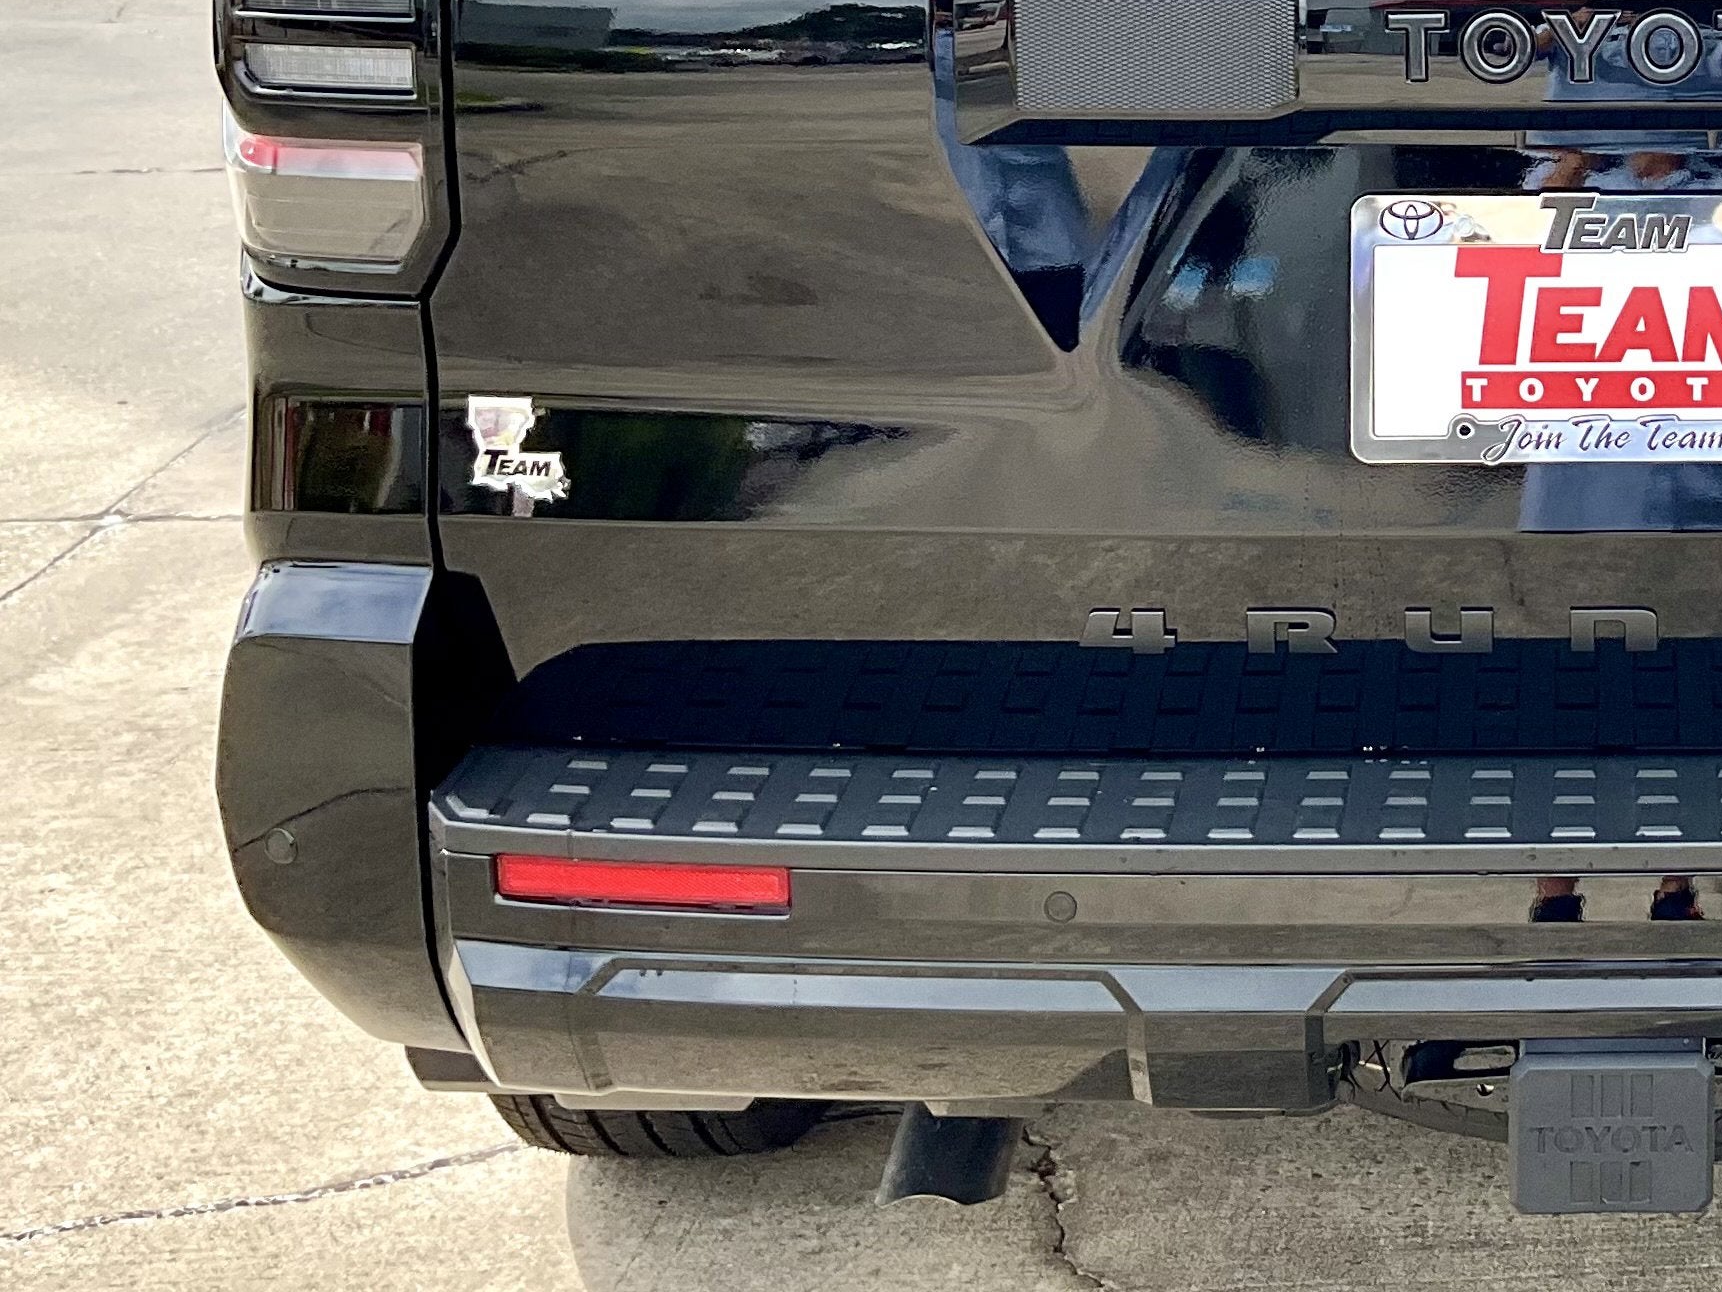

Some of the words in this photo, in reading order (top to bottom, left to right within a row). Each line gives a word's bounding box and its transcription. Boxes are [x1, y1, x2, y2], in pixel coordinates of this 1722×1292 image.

[1540, 195, 1691, 252] TEAM
[1482, 415, 1567, 461] Join
[1572, 417, 1632, 451] The
[484, 449, 552, 477] TEAM
[1530, 1124, 1694, 1154] TOYOTA
